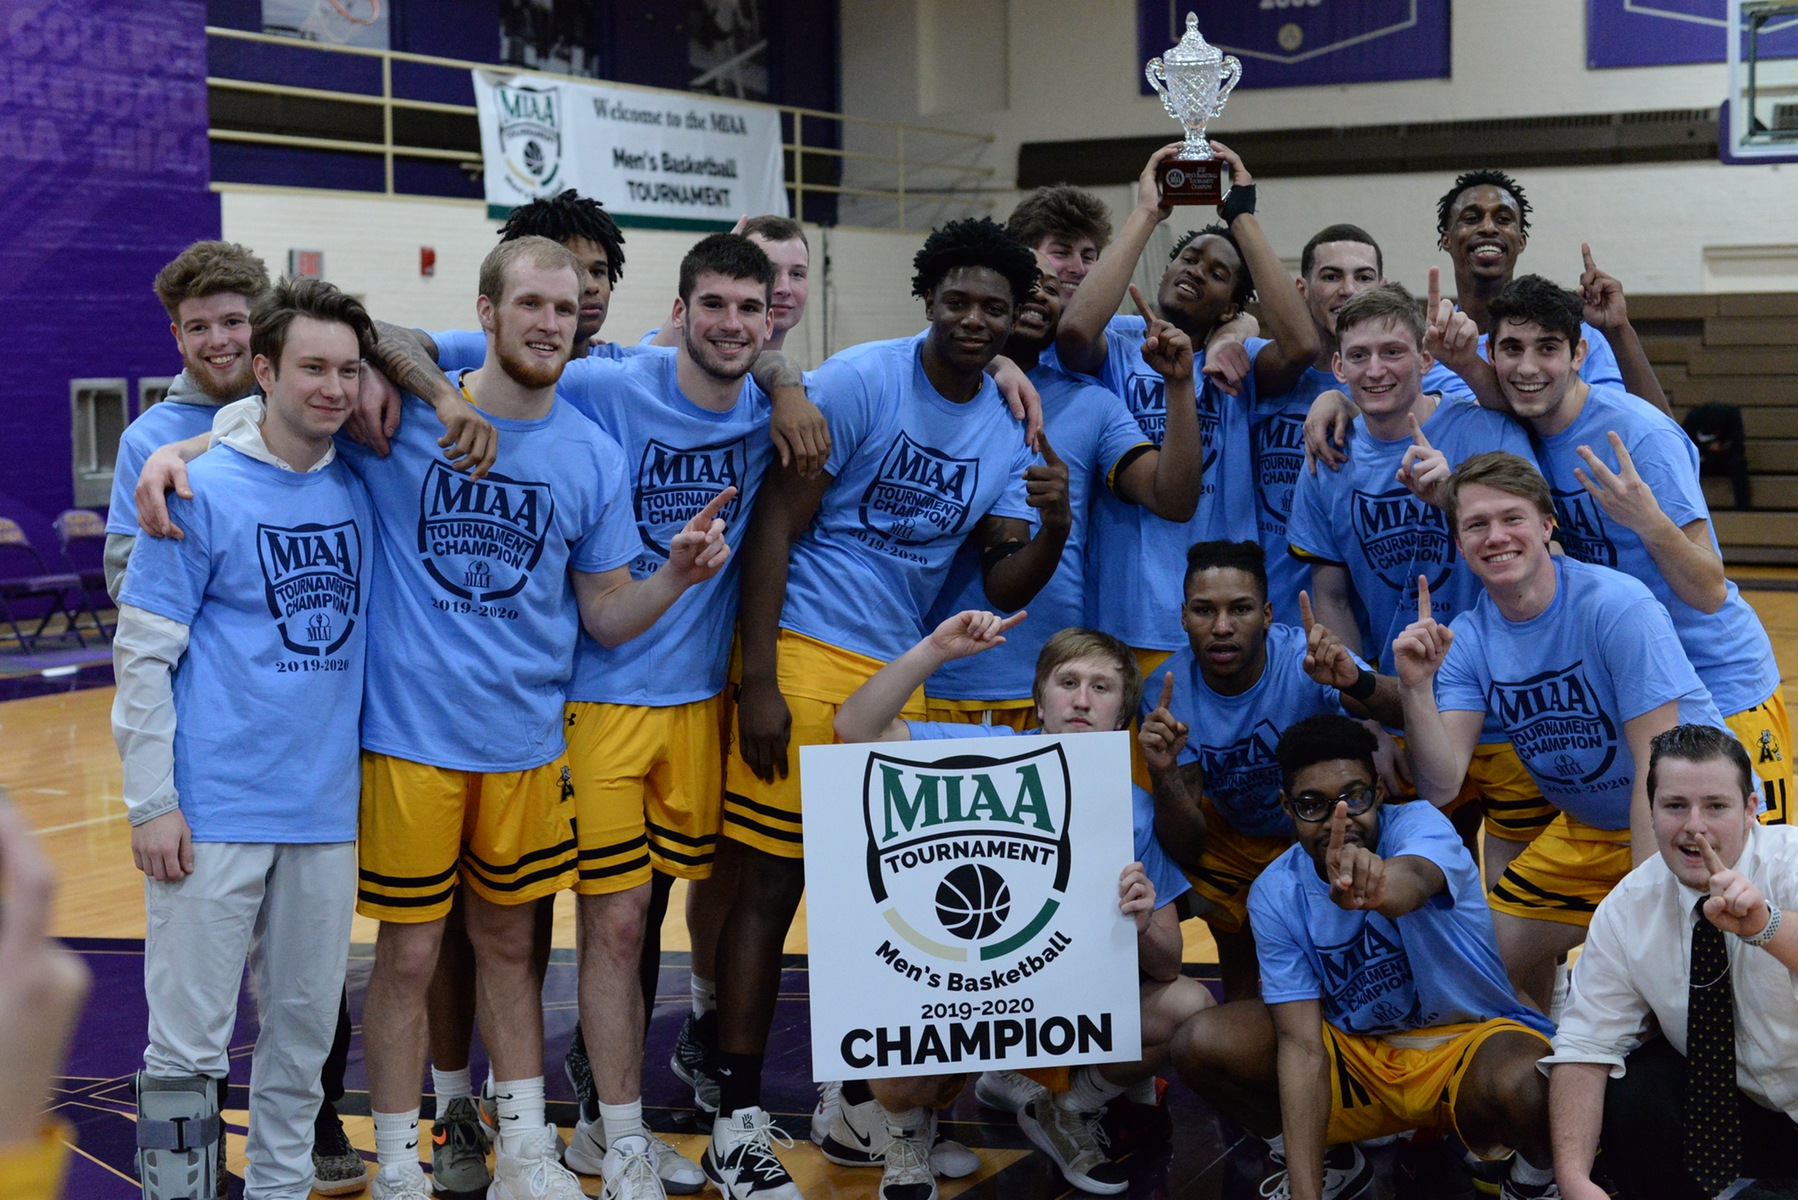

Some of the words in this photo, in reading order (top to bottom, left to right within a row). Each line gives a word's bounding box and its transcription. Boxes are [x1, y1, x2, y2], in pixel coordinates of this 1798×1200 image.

[500, 88, 556, 128] MIAA
[594, 98, 662, 126] Welcome
[666, 111, 682, 128] to
[685, 110, 706, 131] the
[710, 113, 748, 135] MIAA
[612, 148, 657, 172] Men's
[661, 152, 737, 178] Basketball
[627, 180, 731, 208] TOURNAMENT
[645, 446, 738, 490] MIAA
[884, 438, 968, 503] MIAA
[429, 467, 537, 537] MIAA
[873, 500, 951, 532] CHAMPION
[877, 486, 962, 520] TOURNAMENT
[1358, 496, 1445, 540] MIAA
[264, 530, 354, 580] MIAA
[427, 523, 536, 557] TOURNAMENT
[432, 540, 524, 571] CHAMPION
[847, 527, 928, 565] 2019-2020
[276, 576, 355, 603] TOURNAMENT
[285, 593, 350, 619] CHAMPION
[431, 597, 519, 620] 2019-2020
[276, 659, 350, 673] 2019-2020
[1495, 673, 1595, 728] MIAA
[1508, 720, 1601, 748] TOURNAMENT
[1519, 736, 1603, 761] CHAMPION
[878, 763, 1056, 843] MIAA
[885, 840, 1055, 874] TOURNAMENT
[875, 940, 941, 988] Men's
[947, 931, 1072, 992] Basketball
[920, 997, 1034, 1020] 2019-2020
[840, 1013, 1113, 1069] CHAMPION
